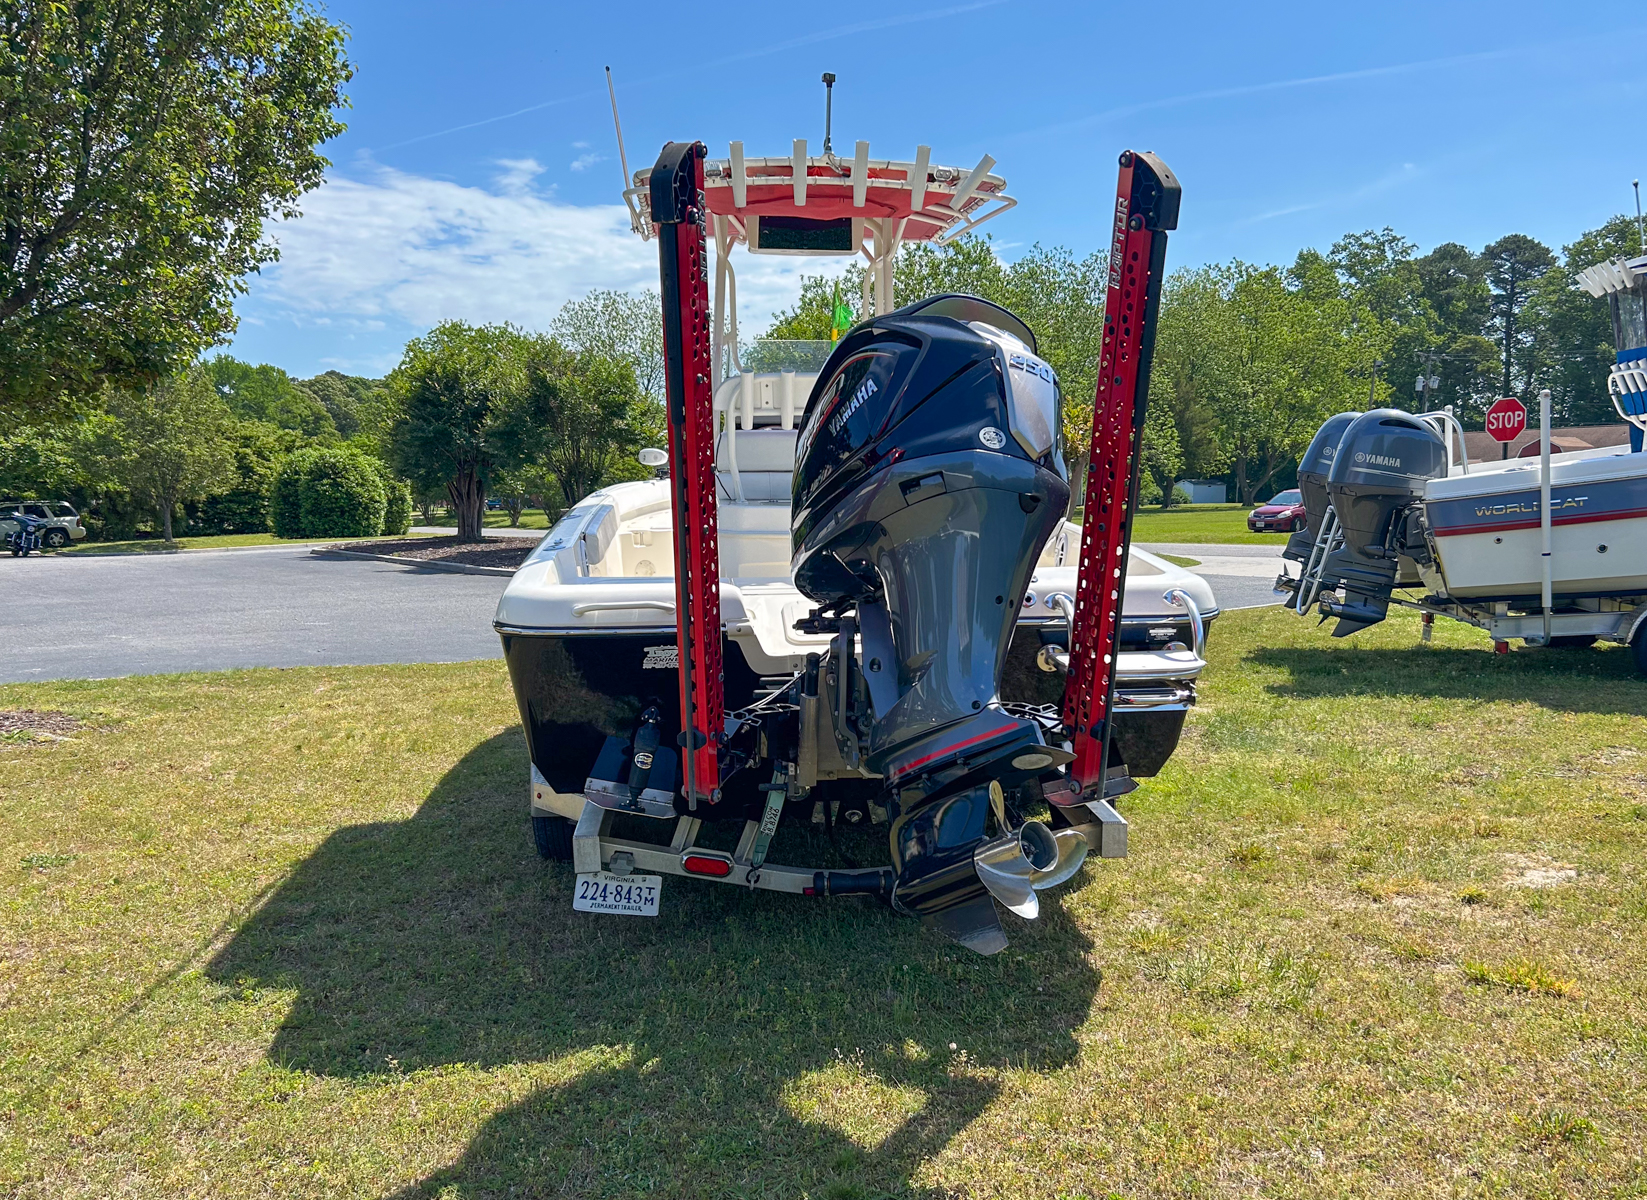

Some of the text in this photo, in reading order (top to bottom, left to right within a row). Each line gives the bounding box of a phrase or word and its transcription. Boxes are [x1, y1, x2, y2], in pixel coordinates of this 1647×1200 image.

[1109, 196, 1129, 290] RAPTOR
[1009, 353, 1052, 384] 250
[828, 378, 879, 438] YAMAHA
[1488, 411, 1524, 430] STOP
[1365, 453, 1401, 468] YAMAHA
[604, 875, 636, 884] VIRGINIA
[590, 902, 642, 912] PERMANENT TRAILER
